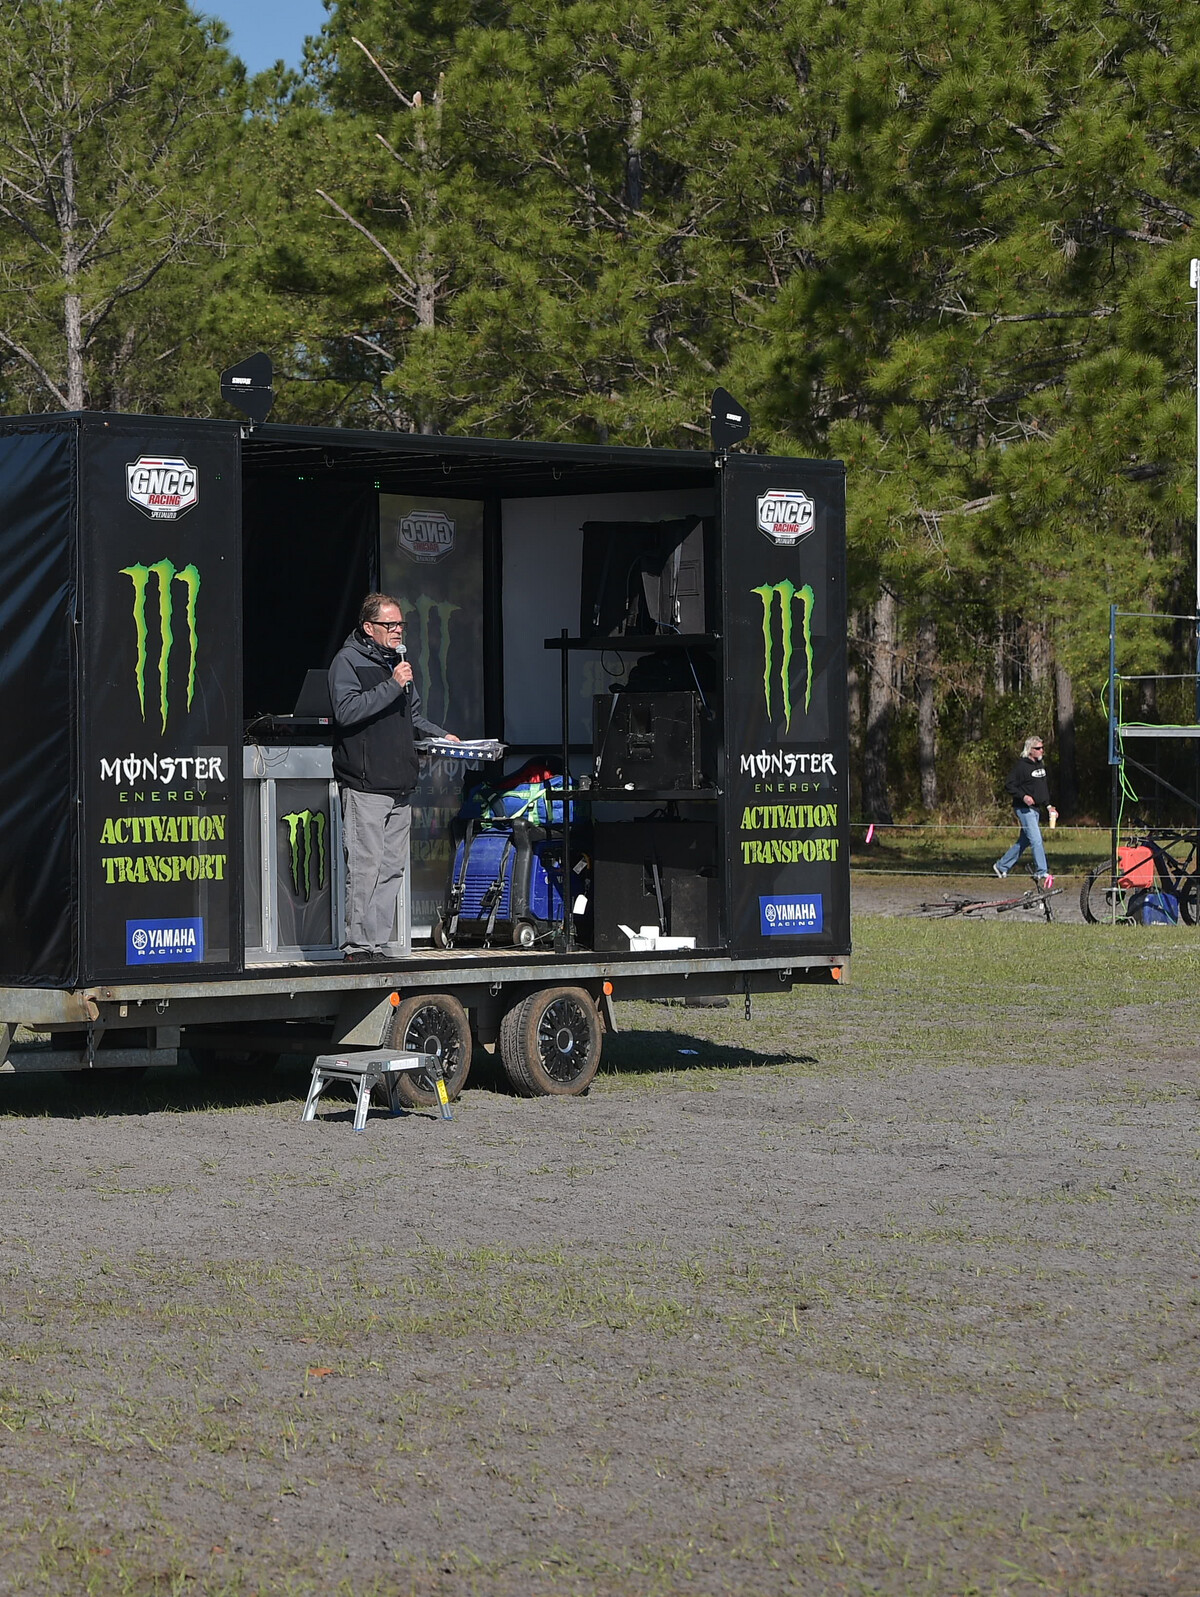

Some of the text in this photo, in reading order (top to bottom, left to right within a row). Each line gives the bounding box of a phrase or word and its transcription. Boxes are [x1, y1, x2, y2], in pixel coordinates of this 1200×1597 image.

[131, 468, 195, 496] GNCC
[148, 494, 181, 505] RACING
[761, 500, 812, 525] GNCC
[773, 523, 800, 533] RACING
[100, 752, 226, 786] MONSTER
[740, 749, 837, 778] MONSTER
[119, 790, 208, 802] ENERGY
[754, 782, 821, 793] ENERGY
[740, 804, 838, 830] ACTIVATION
[100, 815, 226, 845] ACTIVATION
[741, 838, 839, 864] TRANSPORT
[101, 854, 227, 884] TRANSPORT
[775, 903, 817, 921] YAMAHA
[770, 920, 814, 928] RACING
[147, 928, 196, 948] YAMAHA
[138, 947, 193, 956] RACING
